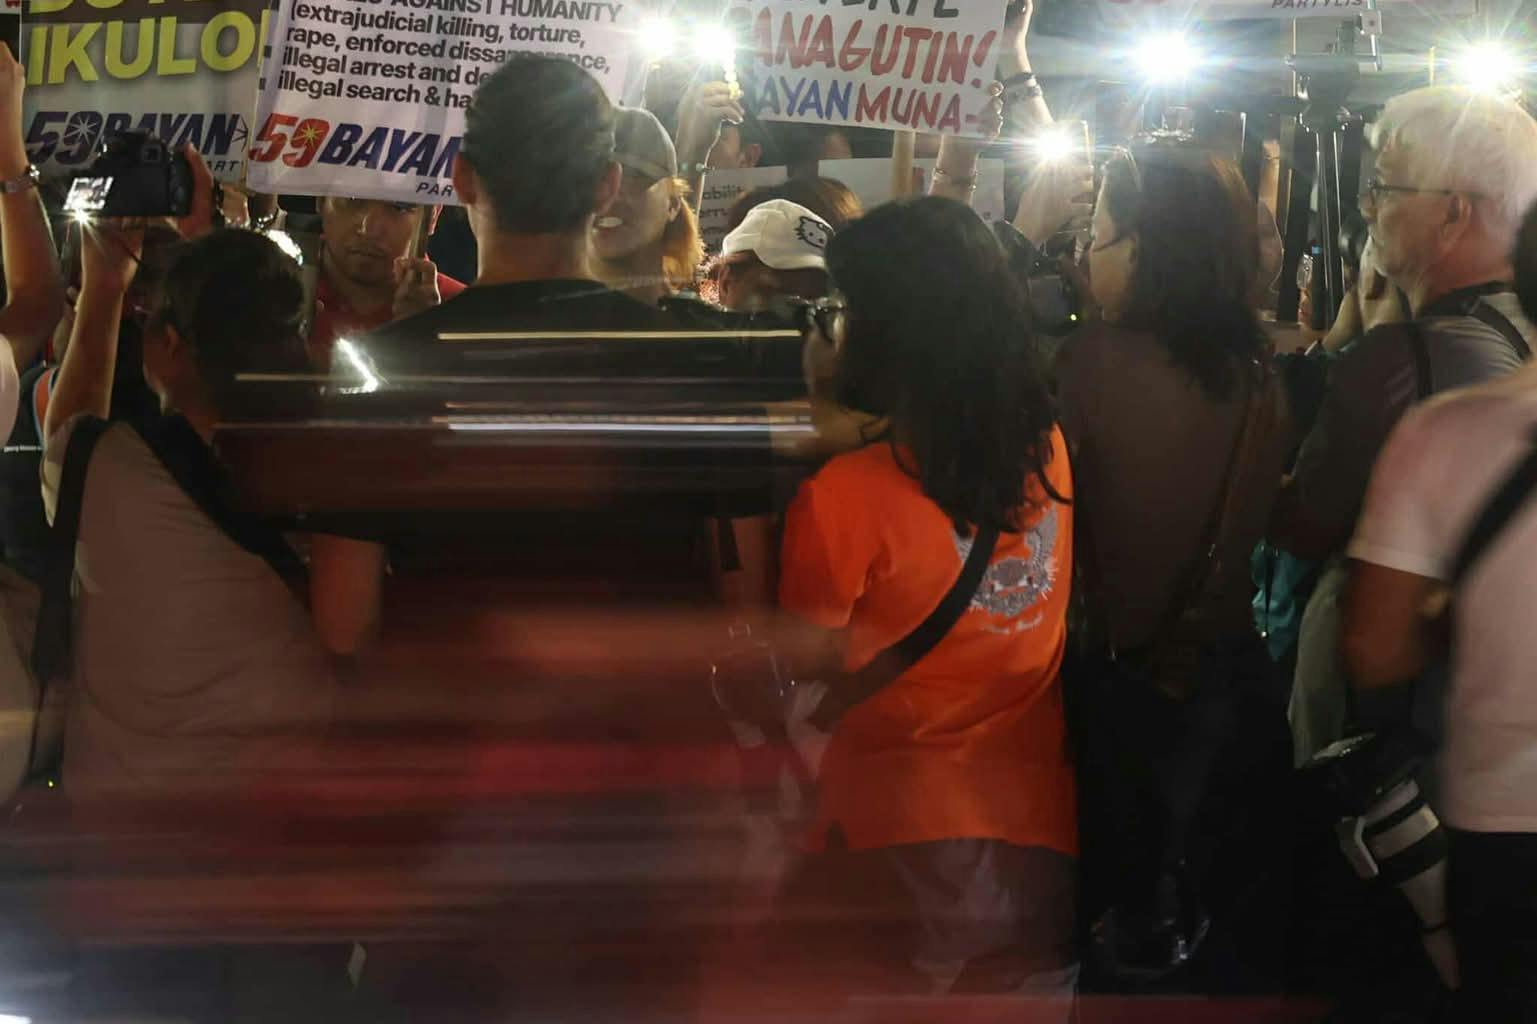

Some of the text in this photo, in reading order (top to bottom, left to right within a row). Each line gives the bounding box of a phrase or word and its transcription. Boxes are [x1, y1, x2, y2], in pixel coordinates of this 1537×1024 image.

[286, 27, 340, 53] rape,
[346, 34, 445, 59] enforced
[436, 14, 504, 43] killing,
[510, 23, 586, 48] torture,
[753, 7, 997, 88] ANAGUTIN!
[282, 47, 347, 75] illegal
[350, 59, 417, 79] arrest
[418, 65, 461, 84] and
[277, 70, 344, 99] illegal
[346, 83, 421, 103] search
[424, 86, 441, 106] &
[762, 76, 853, 120] AYAN
[249, 112, 331, 168] 59
